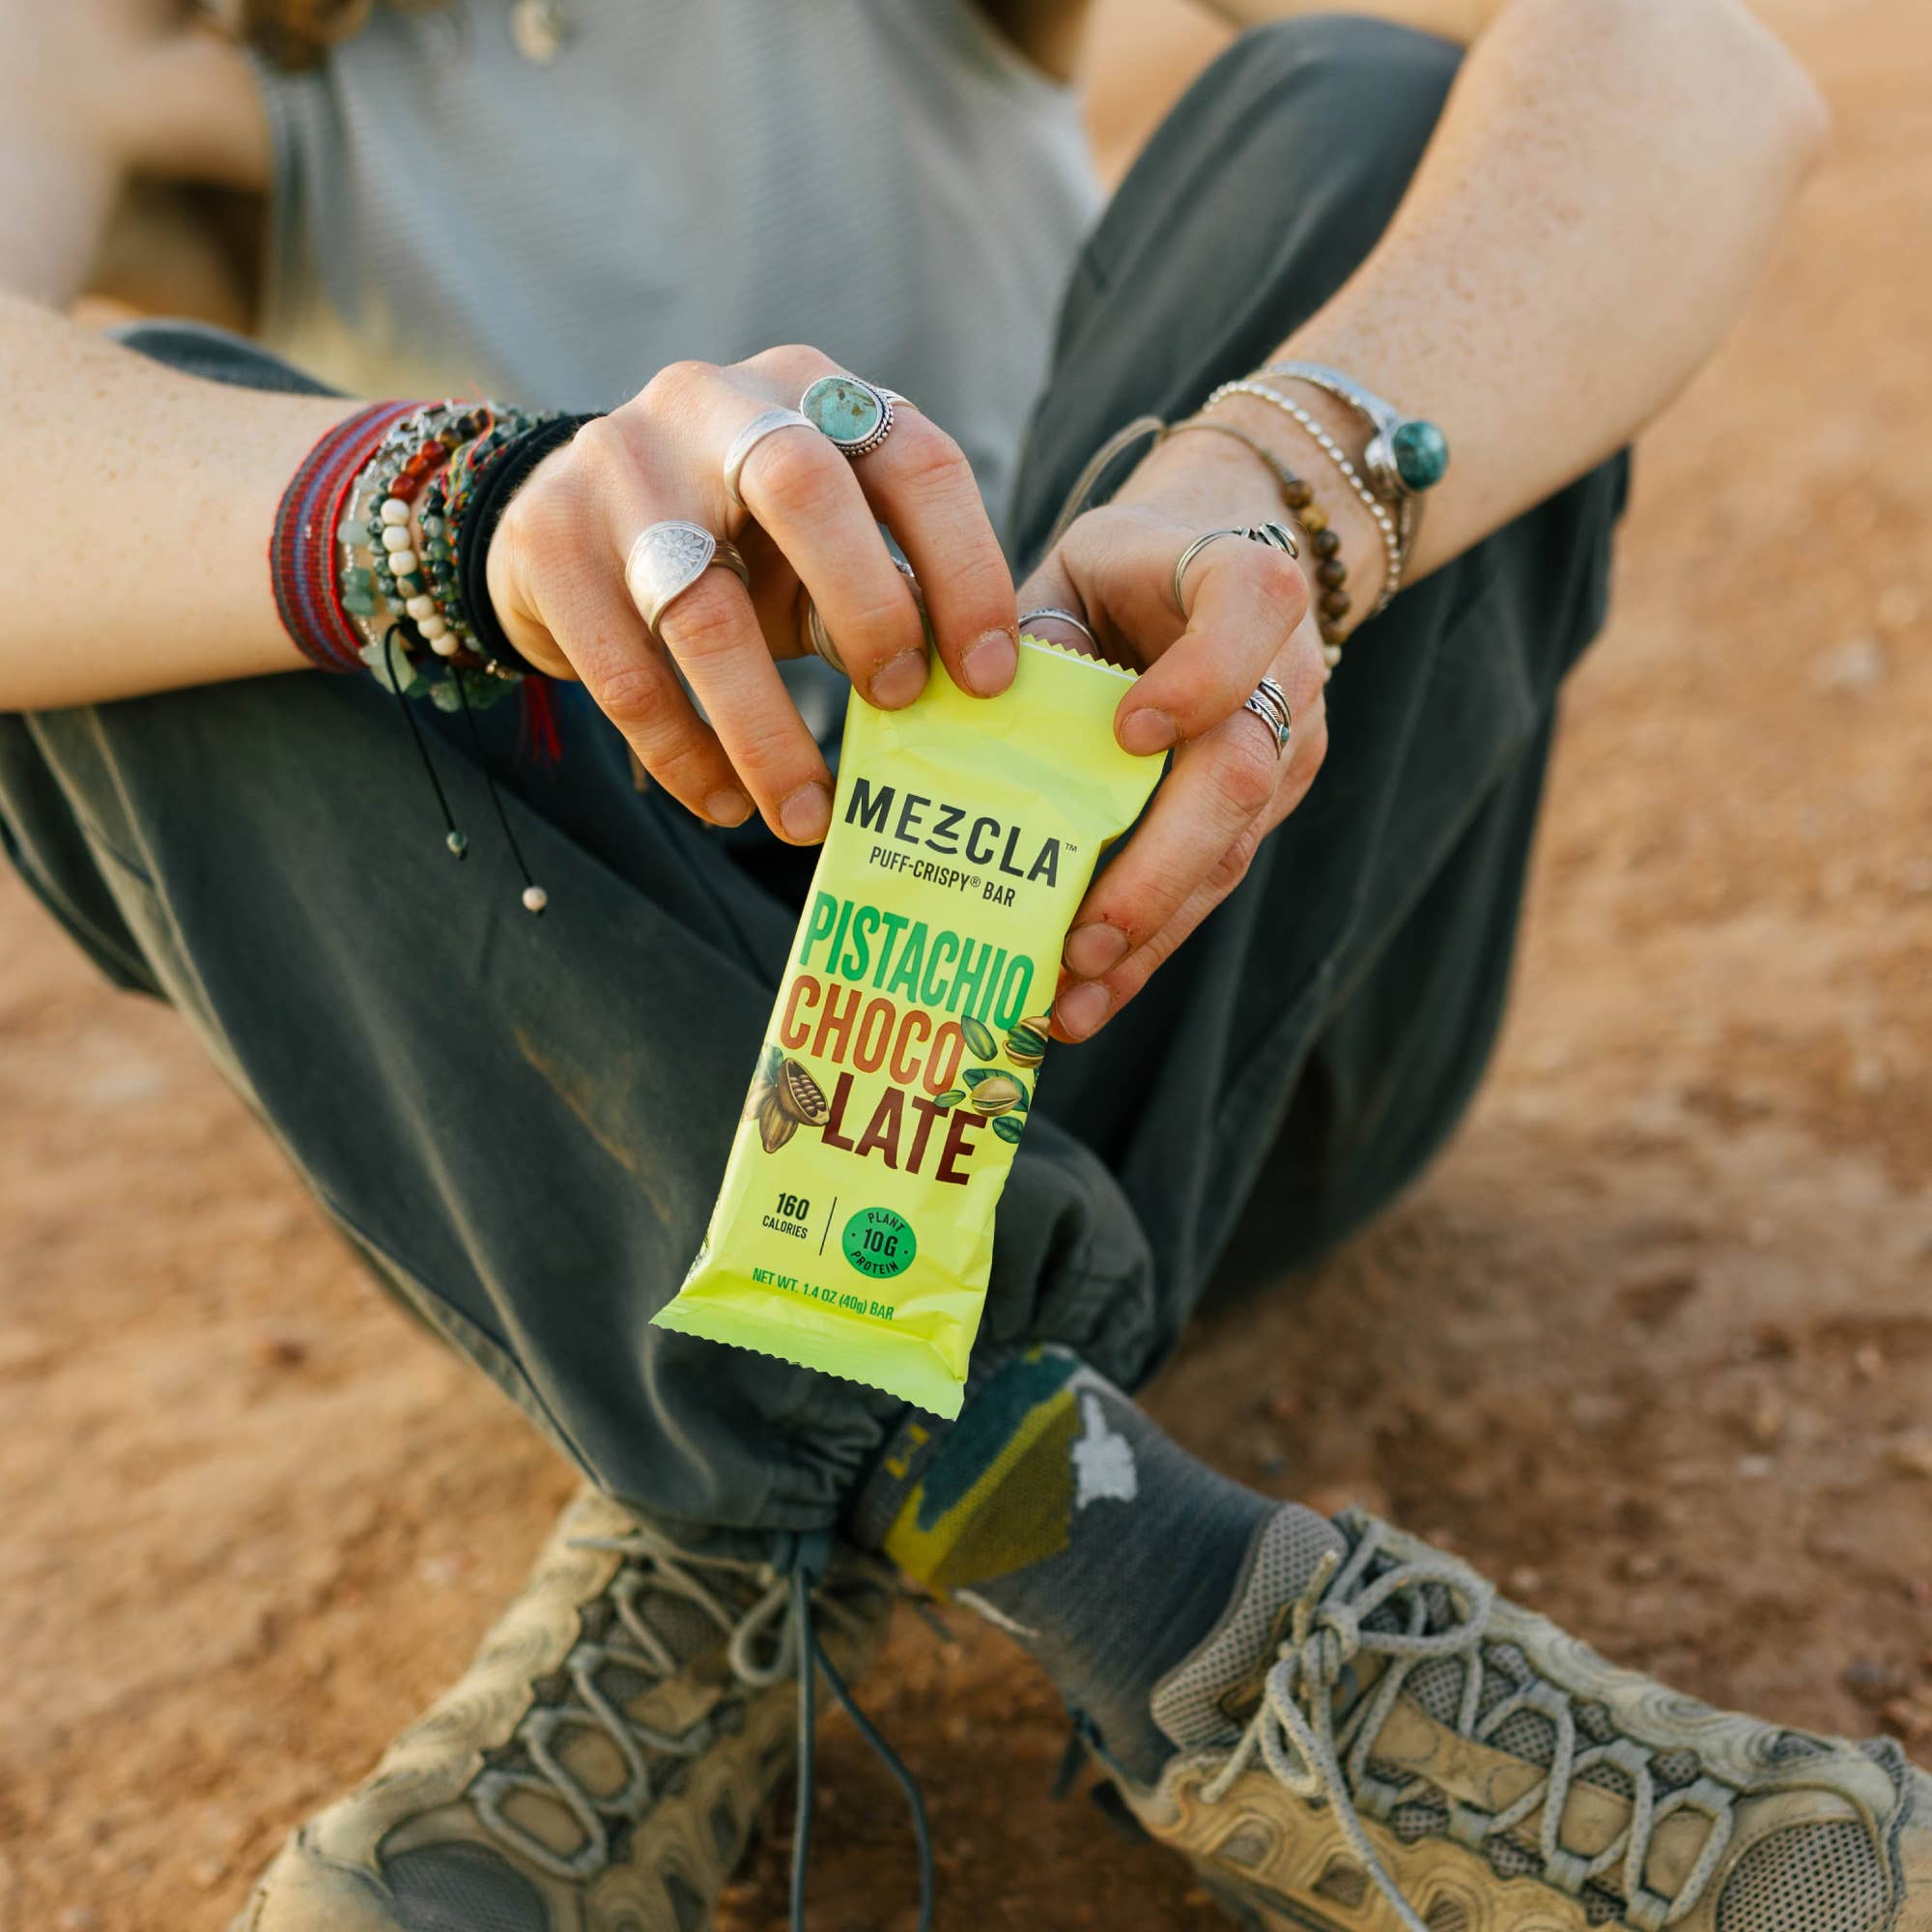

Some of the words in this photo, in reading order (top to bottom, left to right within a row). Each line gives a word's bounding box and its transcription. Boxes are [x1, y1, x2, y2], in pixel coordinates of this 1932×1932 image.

[982, 887, 1015, 907] BAR
[799, 891, 1035, 1031] PISTACHIO
[781, 975, 966, 1096] CHOCO
[821, 1071, 987, 1185] LATE
[776, 1192, 810, 1221] 160
[762, 1214, 808, 1240] CALORIES
[867, 1211, 905, 1233] PLANT
[863, 1228, 898, 1258] 10G
[850, 1250, 899, 1275] PROTEIN
[752, 1267, 775, 1286] NET
[776, 1275, 798, 1293] WT.
[804, 1282, 819, 1298] 1.4
[821, 1287, 838, 1304] OZ
[838, 1292, 867, 1314] (40g)
[869, 1299, 895, 1321] BAR
